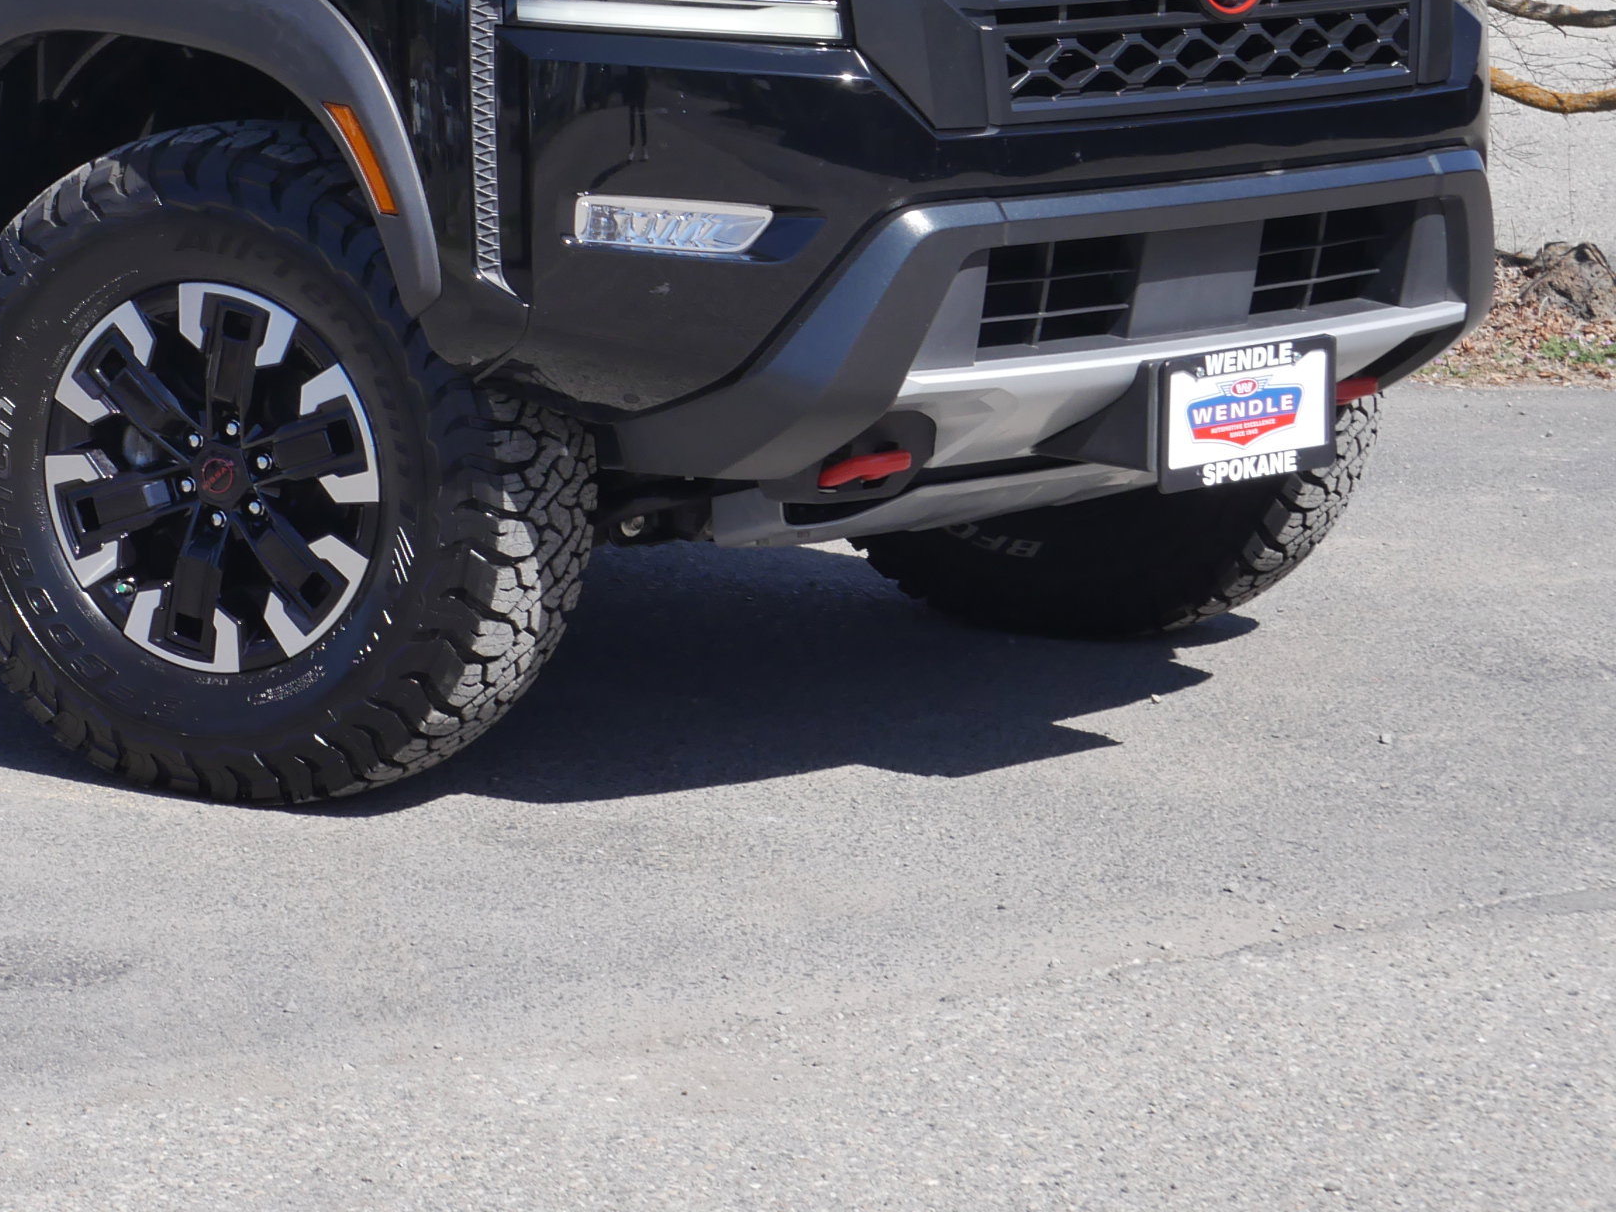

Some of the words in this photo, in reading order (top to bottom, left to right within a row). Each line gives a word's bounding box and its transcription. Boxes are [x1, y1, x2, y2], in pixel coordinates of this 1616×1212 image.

[1204, 341, 1294, 376] WENDLE
[1235, 381, 1254, 394] W
[1192, 394, 1294, 425] WENDLE
[1202, 450, 1297, 487] SPOKANE
